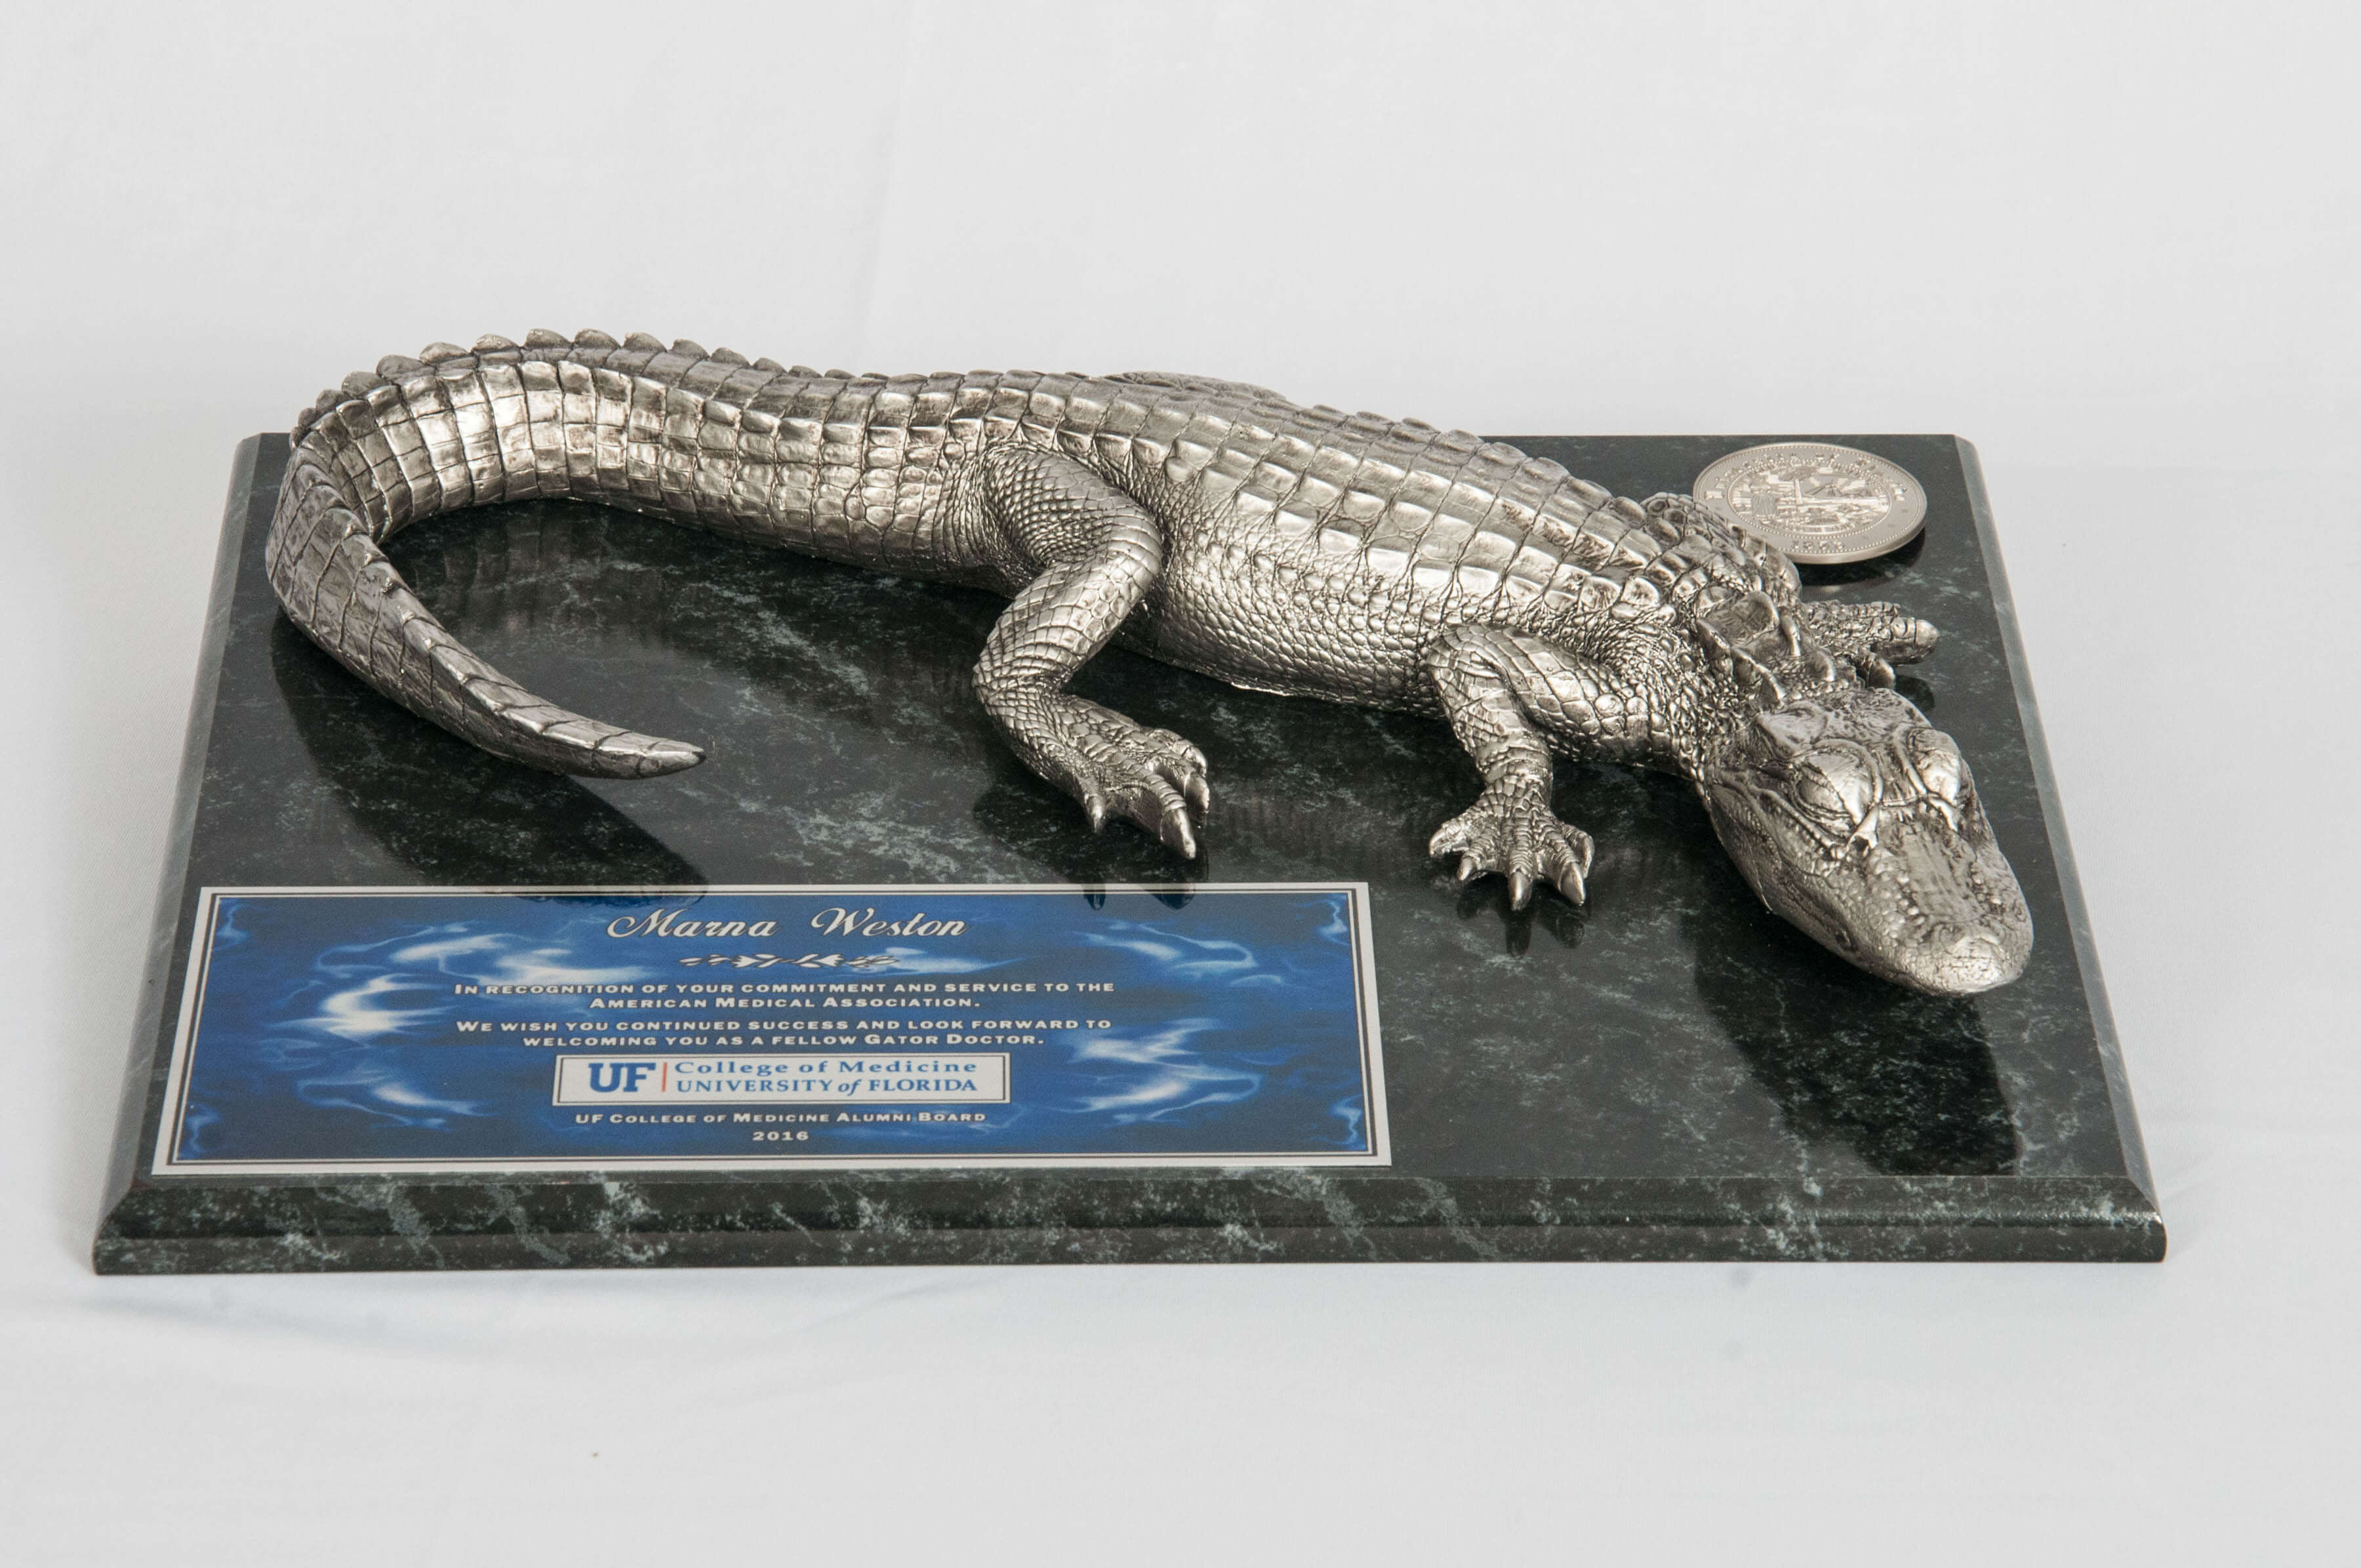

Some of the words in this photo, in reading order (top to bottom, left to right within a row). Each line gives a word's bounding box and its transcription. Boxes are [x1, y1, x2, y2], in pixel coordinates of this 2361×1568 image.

[606, 907, 781, 938] Marna
[811, 907, 969, 937] Weston
[485, 984, 635, 994] RECOGNITION
[641, 984, 670, 994] OF
[676, 984, 735, 994] YOUR
[740, 984, 885, 993] COMMITMENT
[893, 984, 937, 992] AND
[944, 984, 1037, 992] SERVICE
[1043, 984, 1070, 992] TO
[1076, 983, 1115, 992] THE
[500, 1021, 557, 1032] WISH
[564, 1021, 609, 1032] YOU
[615, 1021, 742, 1031] CONTINUED
[748, 1020, 849, 1030] SUCCESS
[856, 1020, 900, 1030] AND
[907, 1020, 964, 1030] LOOK
[971, 1020, 1080, 1030] FORWARD
[1085, 1020, 1112, 1029] TO
[523, 1037, 657, 1047] WELCOMING
[664, 1037, 709, 1046] YOU
[716, 1036, 744, 1045] AS
[751, 1036, 765, 1045] A
[771, 1036, 858, 1045] FELLOW
[674, 1061, 788, 1076] College
[798, 1060, 829, 1073] of
[839, 1060, 977, 1074] Medicine
[588, 1062, 656, 1093] UF
[676, 1079, 833, 1093] UNIVERSITY
[837, 1079, 862, 1096] of
[868, 1079, 978, 1092] FLORIDA
[575, 1114, 603, 1124] UF
[703, 1115, 727, 1123] OF
[752, 1131, 809, 1141] 2016
